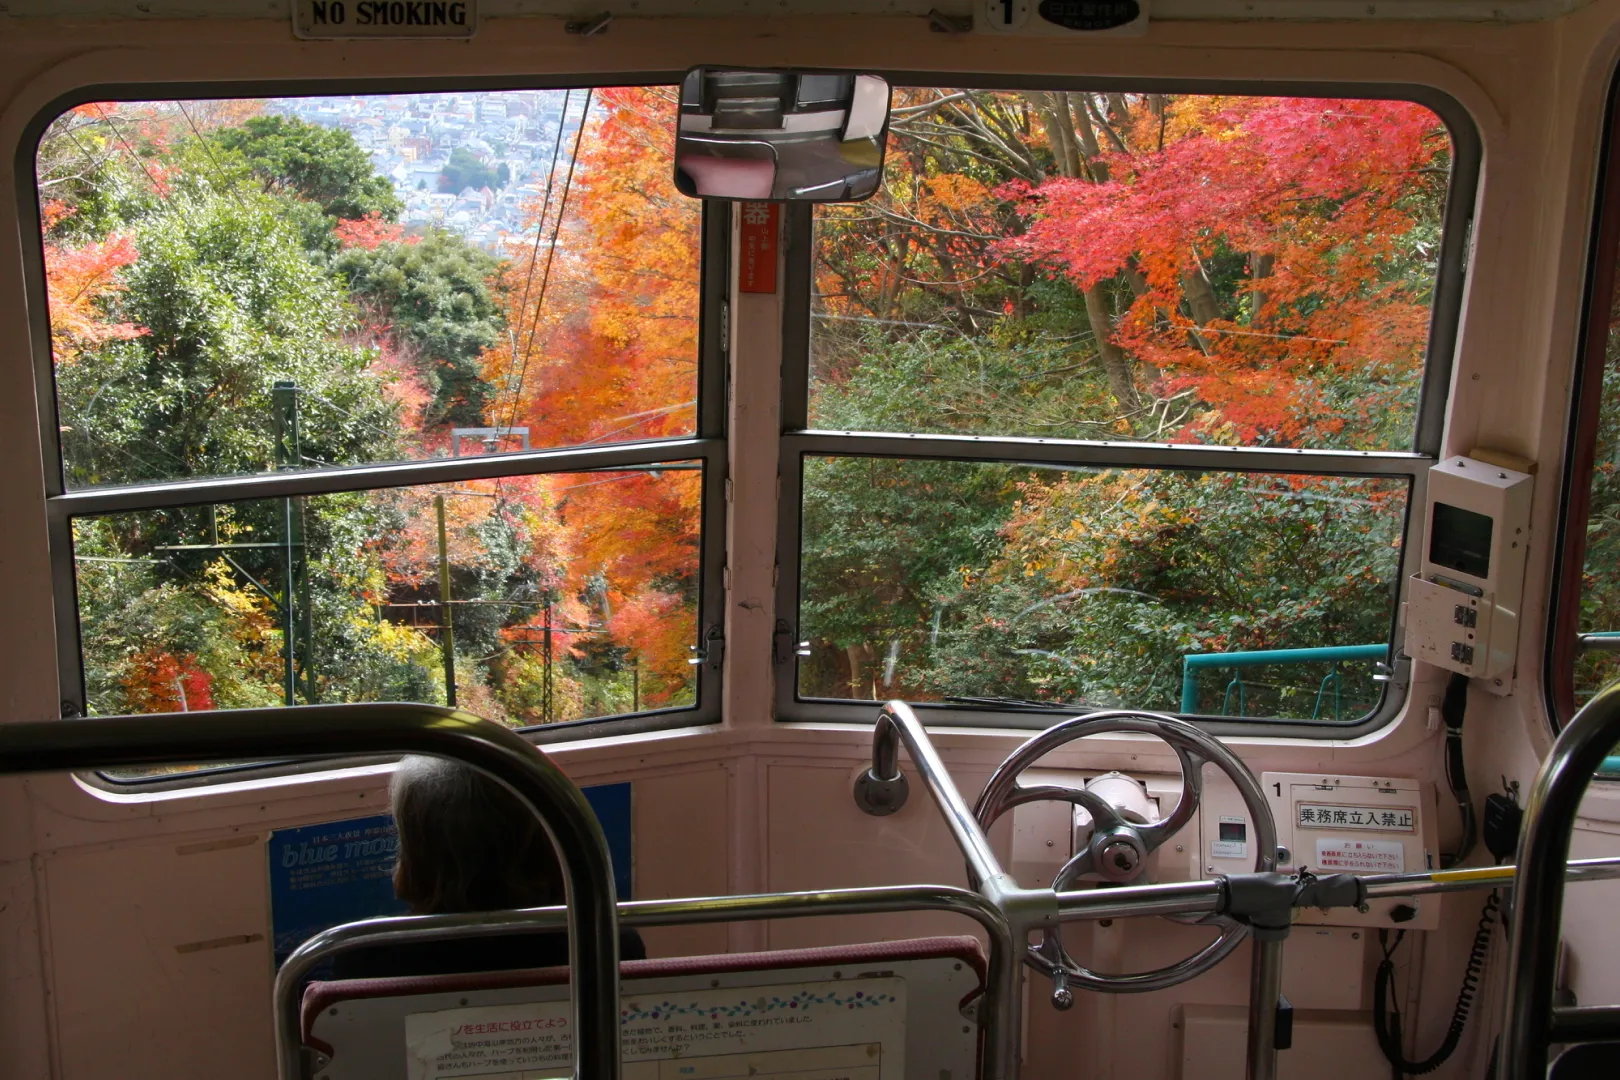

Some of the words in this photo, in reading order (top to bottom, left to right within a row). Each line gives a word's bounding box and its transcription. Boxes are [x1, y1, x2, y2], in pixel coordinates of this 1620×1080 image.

[312, 1, 345, 25] NO
[356, 1, 466, 25] SMOKING
[1000, 0, 1013, 25] 1
[1272, 782, 1281, 797] 1
[1301, 807, 1414, 828] 乗務席立入禁止
[281, 841, 339, 868] blue
